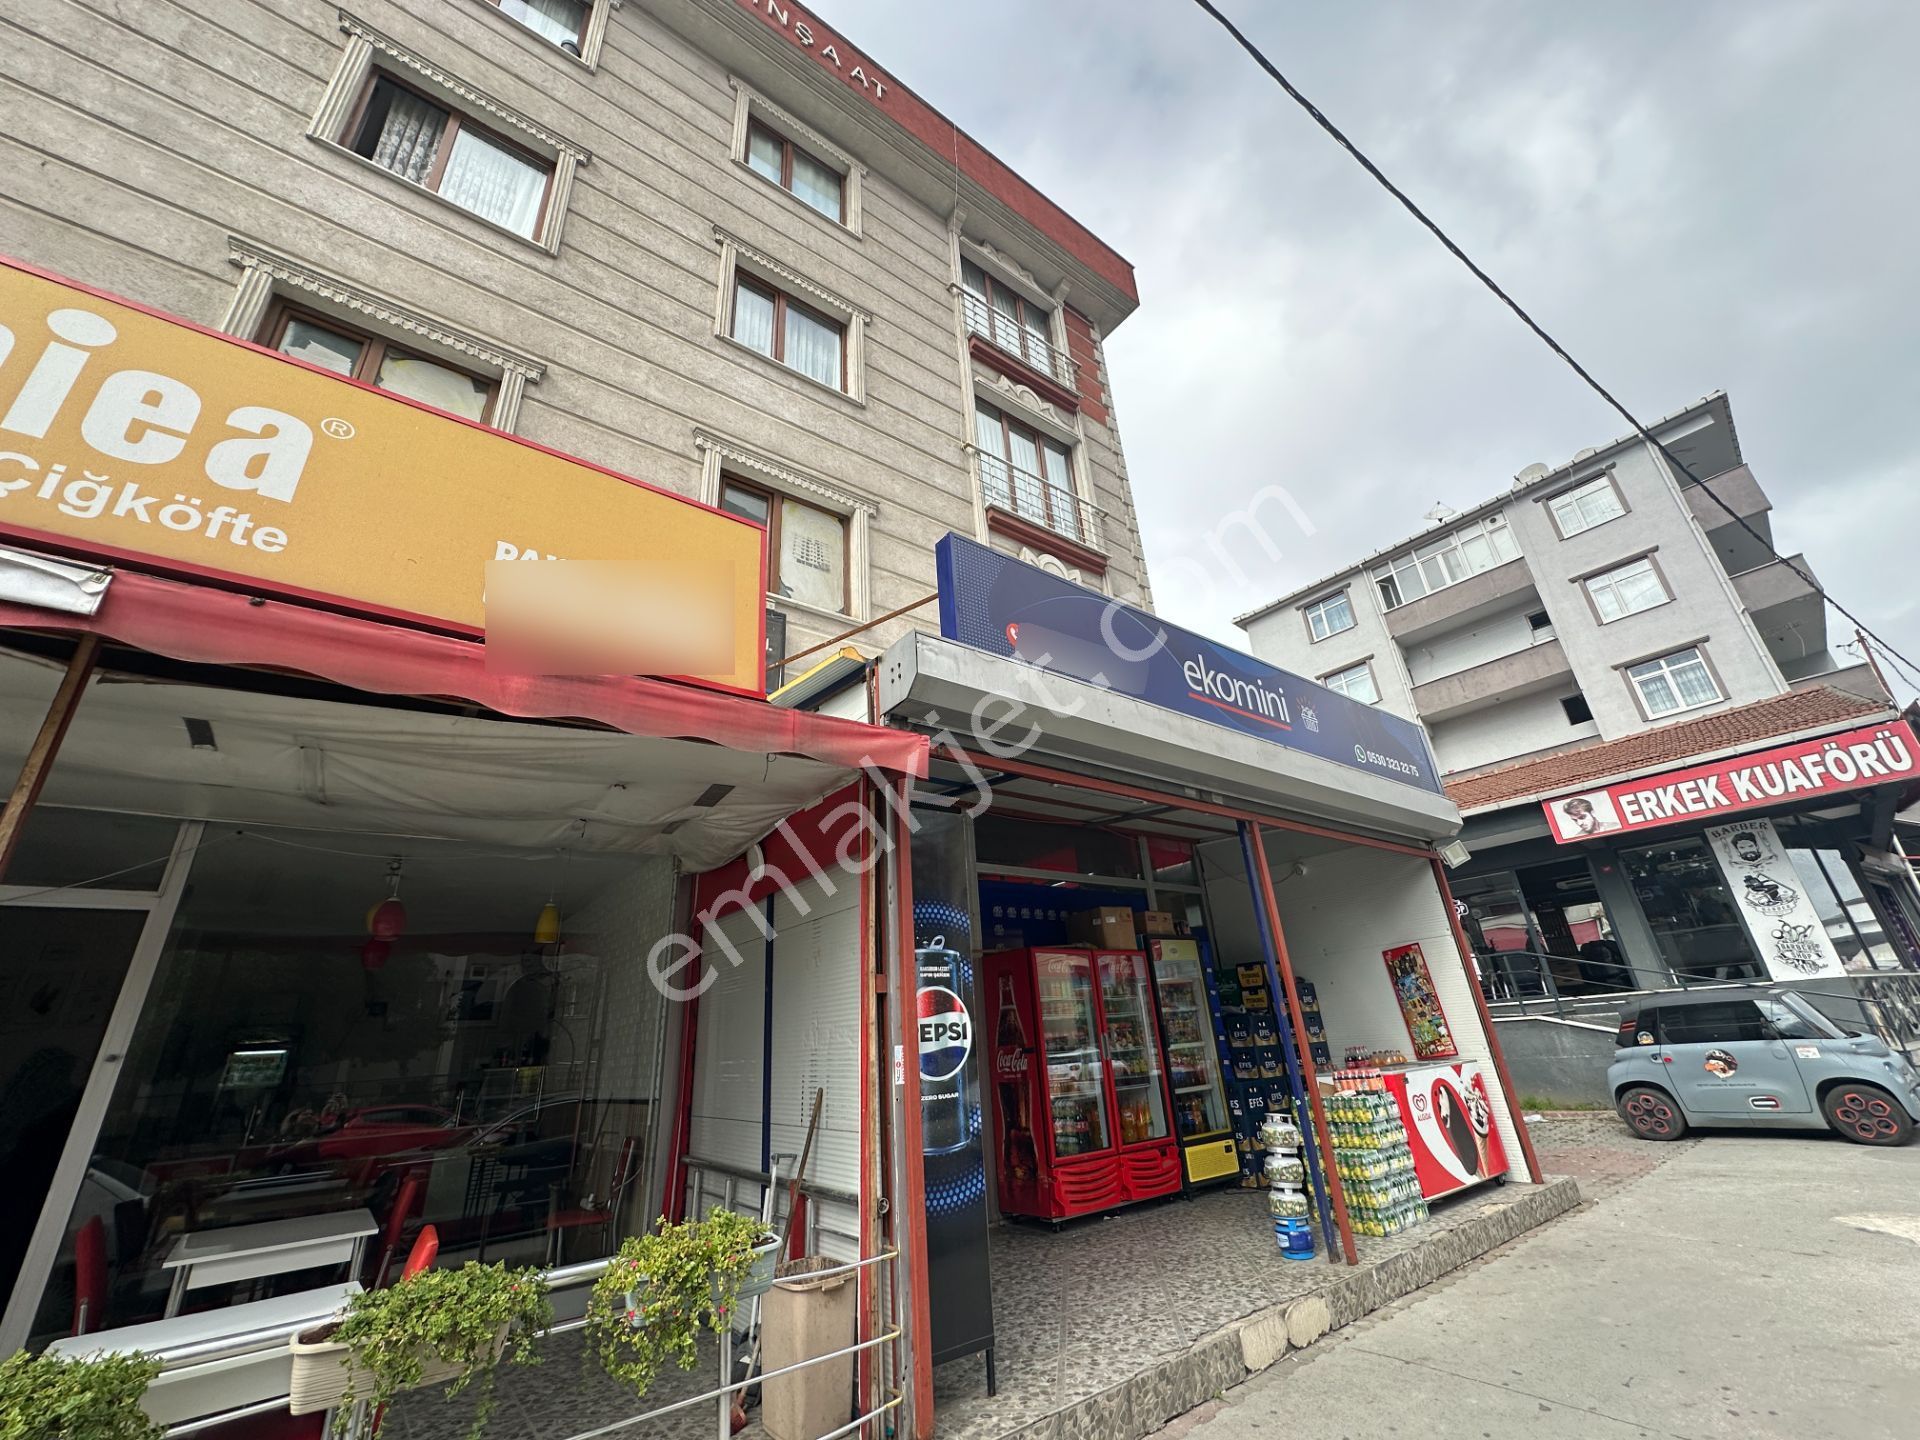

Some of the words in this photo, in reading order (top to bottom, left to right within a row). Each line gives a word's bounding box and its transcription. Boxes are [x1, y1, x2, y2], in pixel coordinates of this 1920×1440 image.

[753, 0, 887, 99] NŞAAT
[0, 451, 288, 552] Çiğköfte
[1183, 654, 1290, 723] ekomini
[1366, 751, 1386, 767] 0530
[1618, 775, 1731, 825] ERKEK
[1729, 731, 1913, 801] KUAFÖRÜ
[1711, 822, 1768, 838] BARBER
[920, 1022, 968, 1042] EPSI
[921, 1093, 938, 1101] ZERO
[938, 1092, 959, 1100] SUGAR
[1248, 1097, 1264, 1108] EFES
